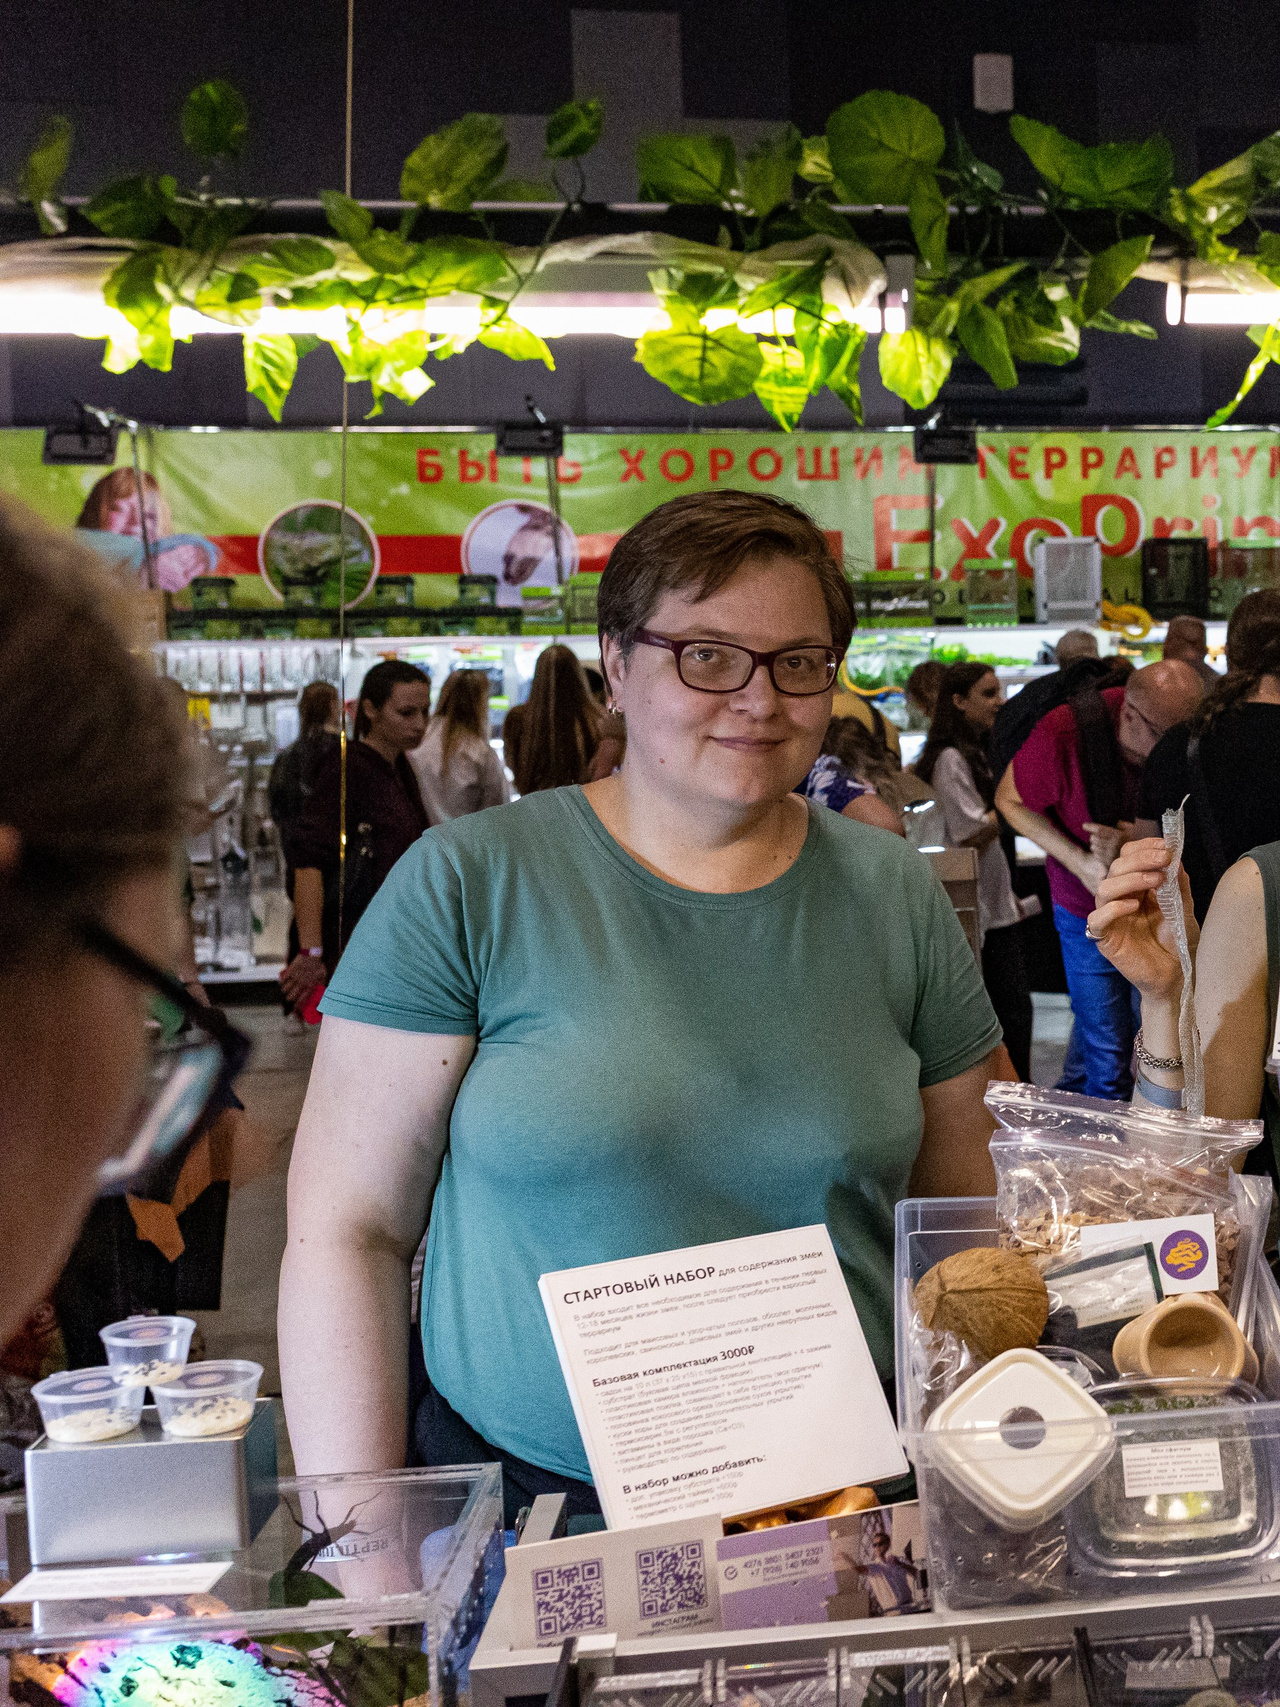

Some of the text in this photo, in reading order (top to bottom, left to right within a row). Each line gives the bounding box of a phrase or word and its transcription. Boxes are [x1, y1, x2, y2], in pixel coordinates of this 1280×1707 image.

[563, 1275, 660, 1305] СТАРТОВЫЙ
[663, 1265, 717, 1286] НАБОР
[717, 1267, 736, 1278] для
[737, 1255, 797, 1272] содержания
[591, 1371, 640, 1388] Базовая
[641, 1354, 718, 1377] комплектация
[622, 1454, 767, 1494] В набор можно добавить:
